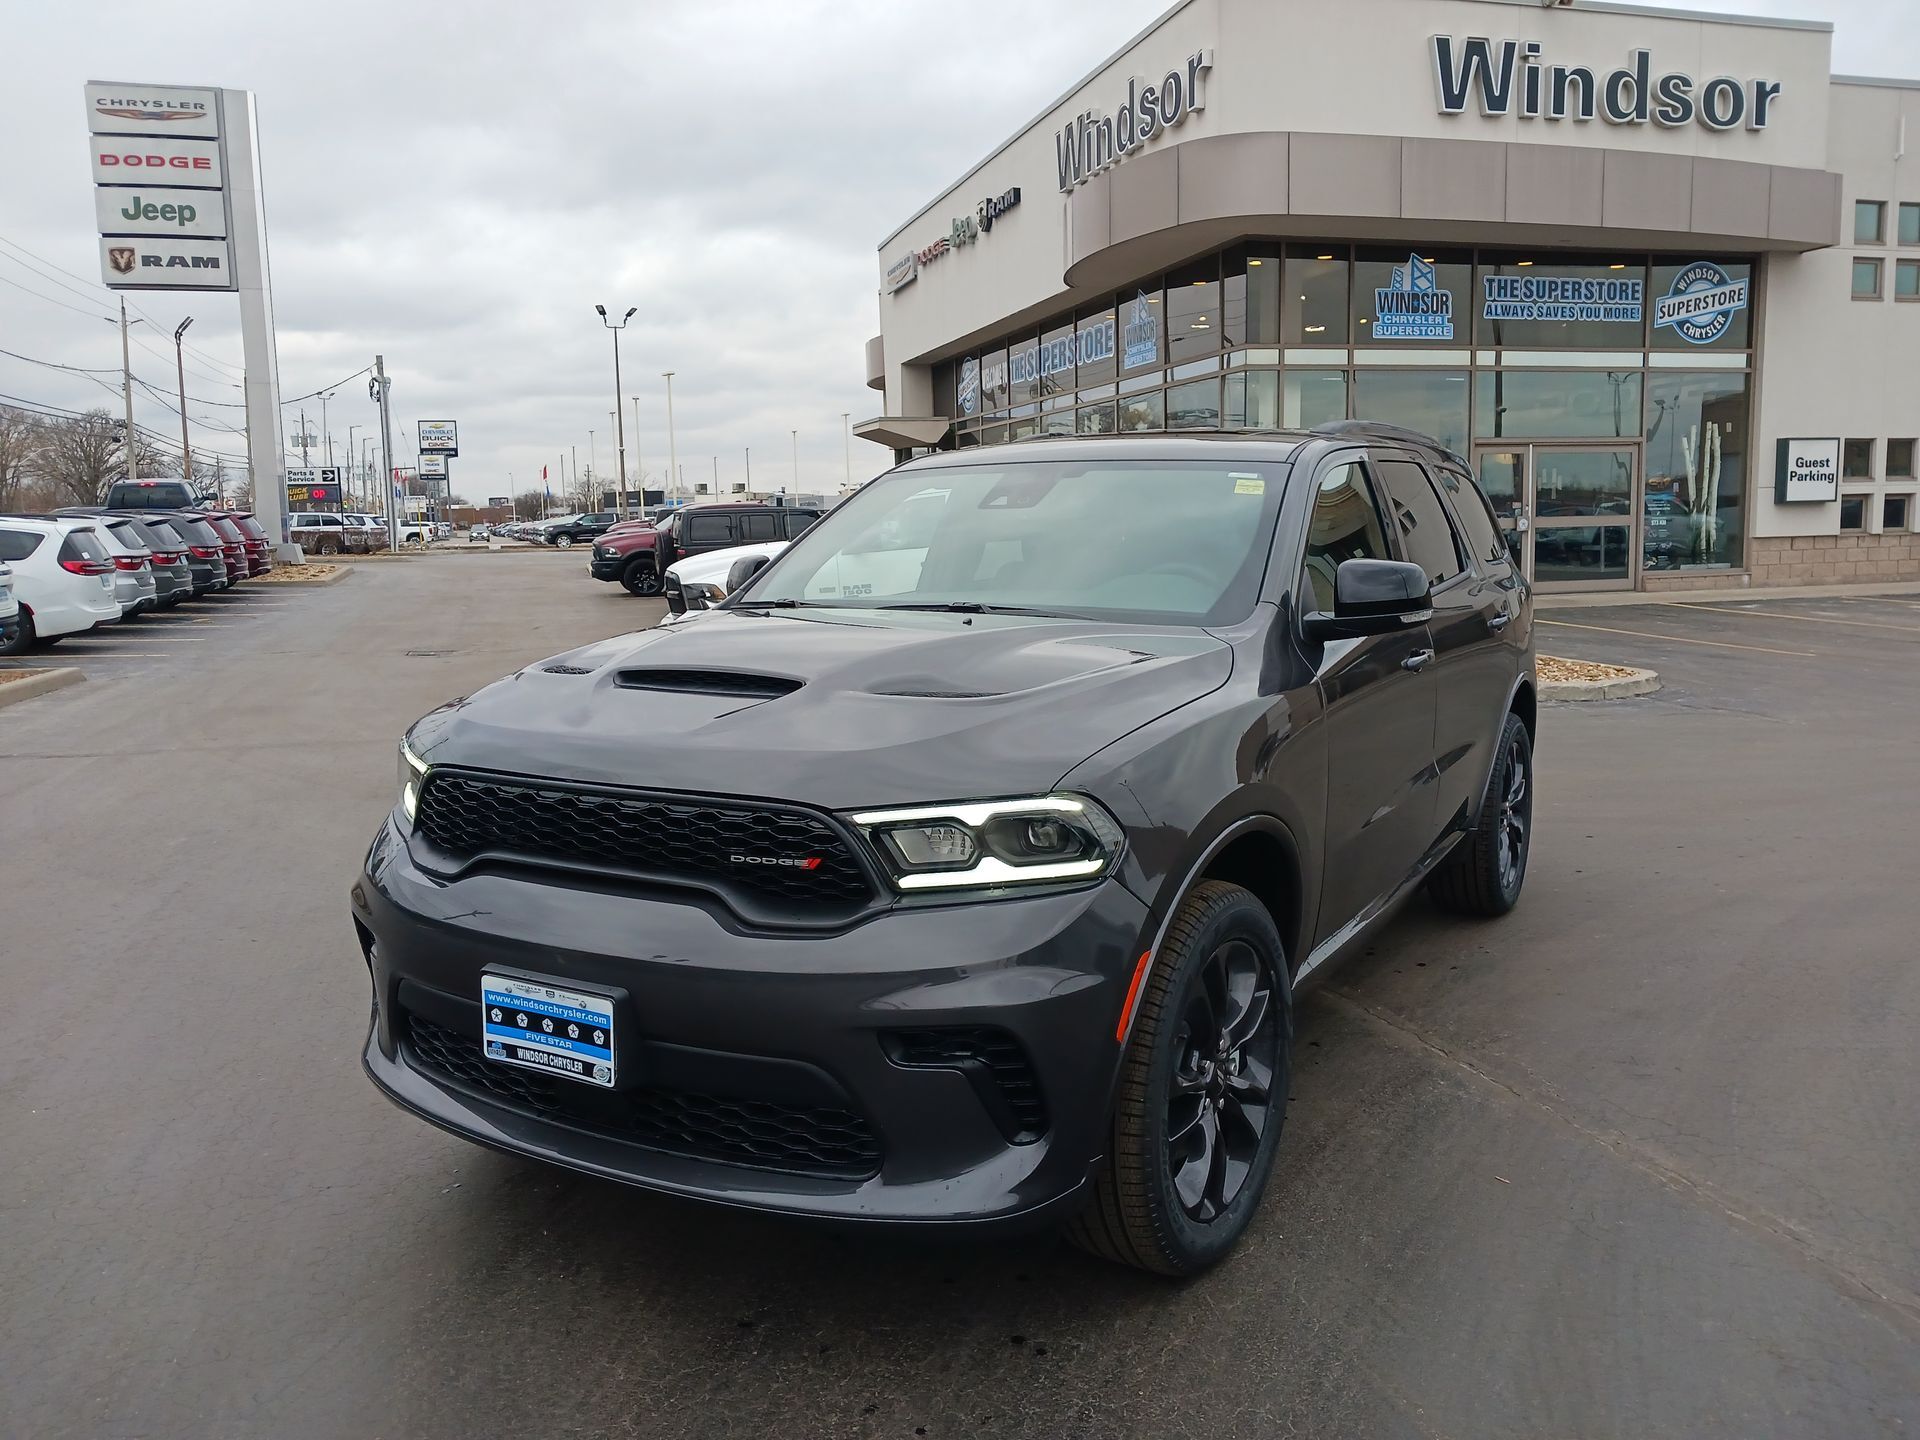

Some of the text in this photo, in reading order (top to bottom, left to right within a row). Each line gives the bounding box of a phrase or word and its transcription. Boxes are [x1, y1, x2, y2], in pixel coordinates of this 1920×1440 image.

[1428, 33, 1782, 131] Windsor
[96, 98, 205, 110] CHRYSLER
[1054, 48, 1213, 194] Windsor
[99, 154, 212, 169] DODGE
[121, 196, 196, 227] Jeep
[987, 187, 1021, 219] RAM
[141, 255, 220, 269] RAM
[1486, 278, 1641, 301] THE SUPERSTORE
[1677, 268, 1720, 291] WINDSOR
[1377, 291, 1449, 314] WINDSOR
[1485, 304, 1640, 319] ALWAYS SAVES YOU MORE!
[1658, 287, 1744, 320] SUPERSTORE
[1375, 325, 1451, 336] SUPERSTORE
[1383, 315, 1443, 325] CHRYSLER
[1683, 314, 1726, 339] CHRYSLER
[1010, 354, 1025, 383] THE
[1026, 325, 1113, 380] SUPERSTORE
[1795, 457, 1830, 468] Guest
[1790, 471, 1835, 483] Parking
[730, 855, 809, 867] DODGE
[487, 993, 607, 1025] www.windsorchrysler.com
[526, 1032, 573, 1049] FIVE STAR
[516, 1047, 549, 1066] WINDSOR
[549, 1053, 583, 1074] CHRYSLER
